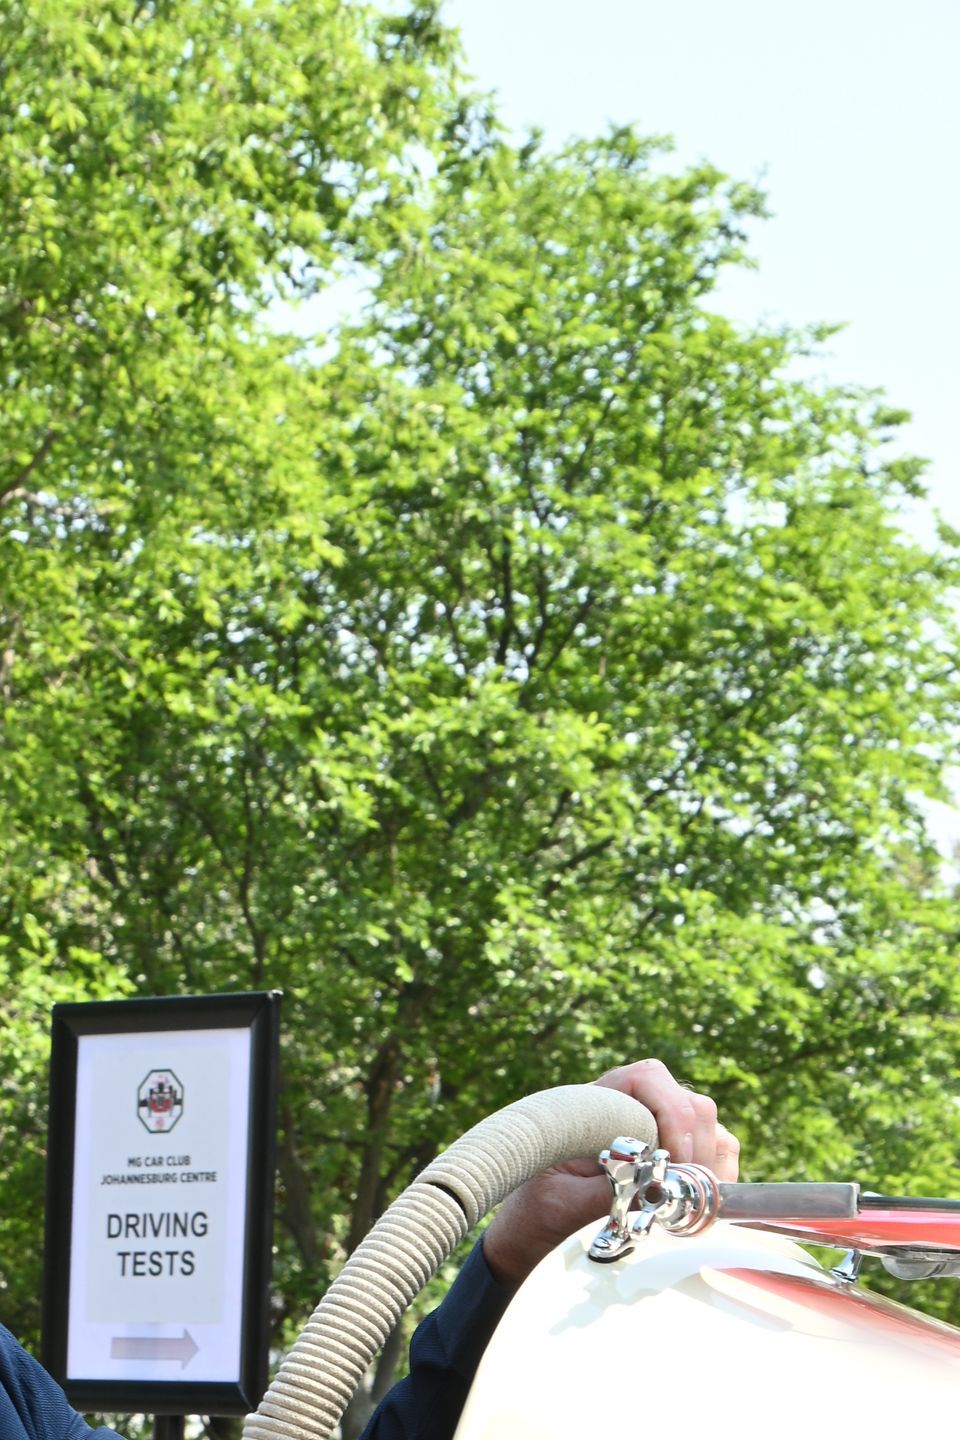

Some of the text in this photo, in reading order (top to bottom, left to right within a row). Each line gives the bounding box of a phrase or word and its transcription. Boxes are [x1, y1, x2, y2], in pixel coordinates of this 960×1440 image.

[127, 1155, 191, 1167] MG CAR CLUB
[100, 1171, 217, 1185] JOHANNESBURG CENTRE
[107, 1211, 208, 1239] DRIVING
[117, 1250, 195, 1277] TESTS
